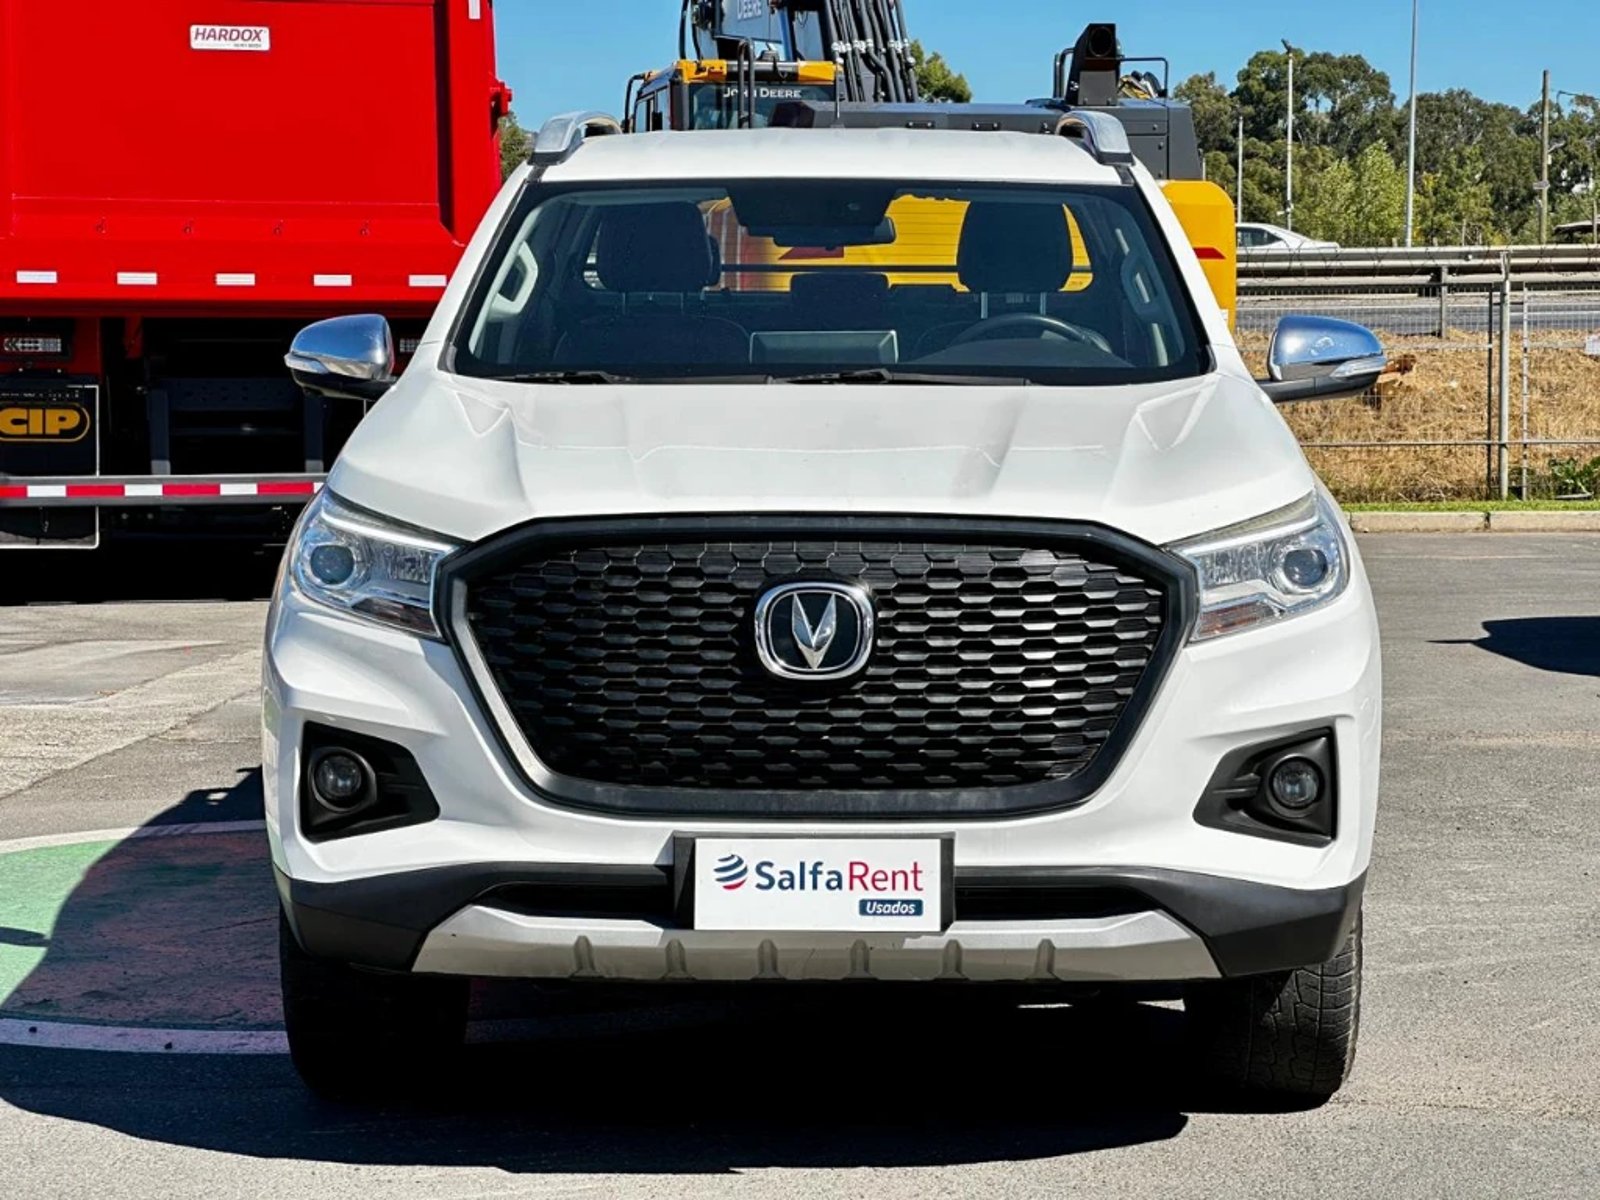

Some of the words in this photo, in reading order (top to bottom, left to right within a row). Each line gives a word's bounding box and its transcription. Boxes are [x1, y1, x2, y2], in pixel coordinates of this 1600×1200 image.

[194, 27, 264, 42] HARDOX
[760, 87, 802, 98] DEERE
[0, 407, 80, 435] CIP
[755, 861, 923, 892] SalfaRent
[865, 901, 916, 915] Usados
